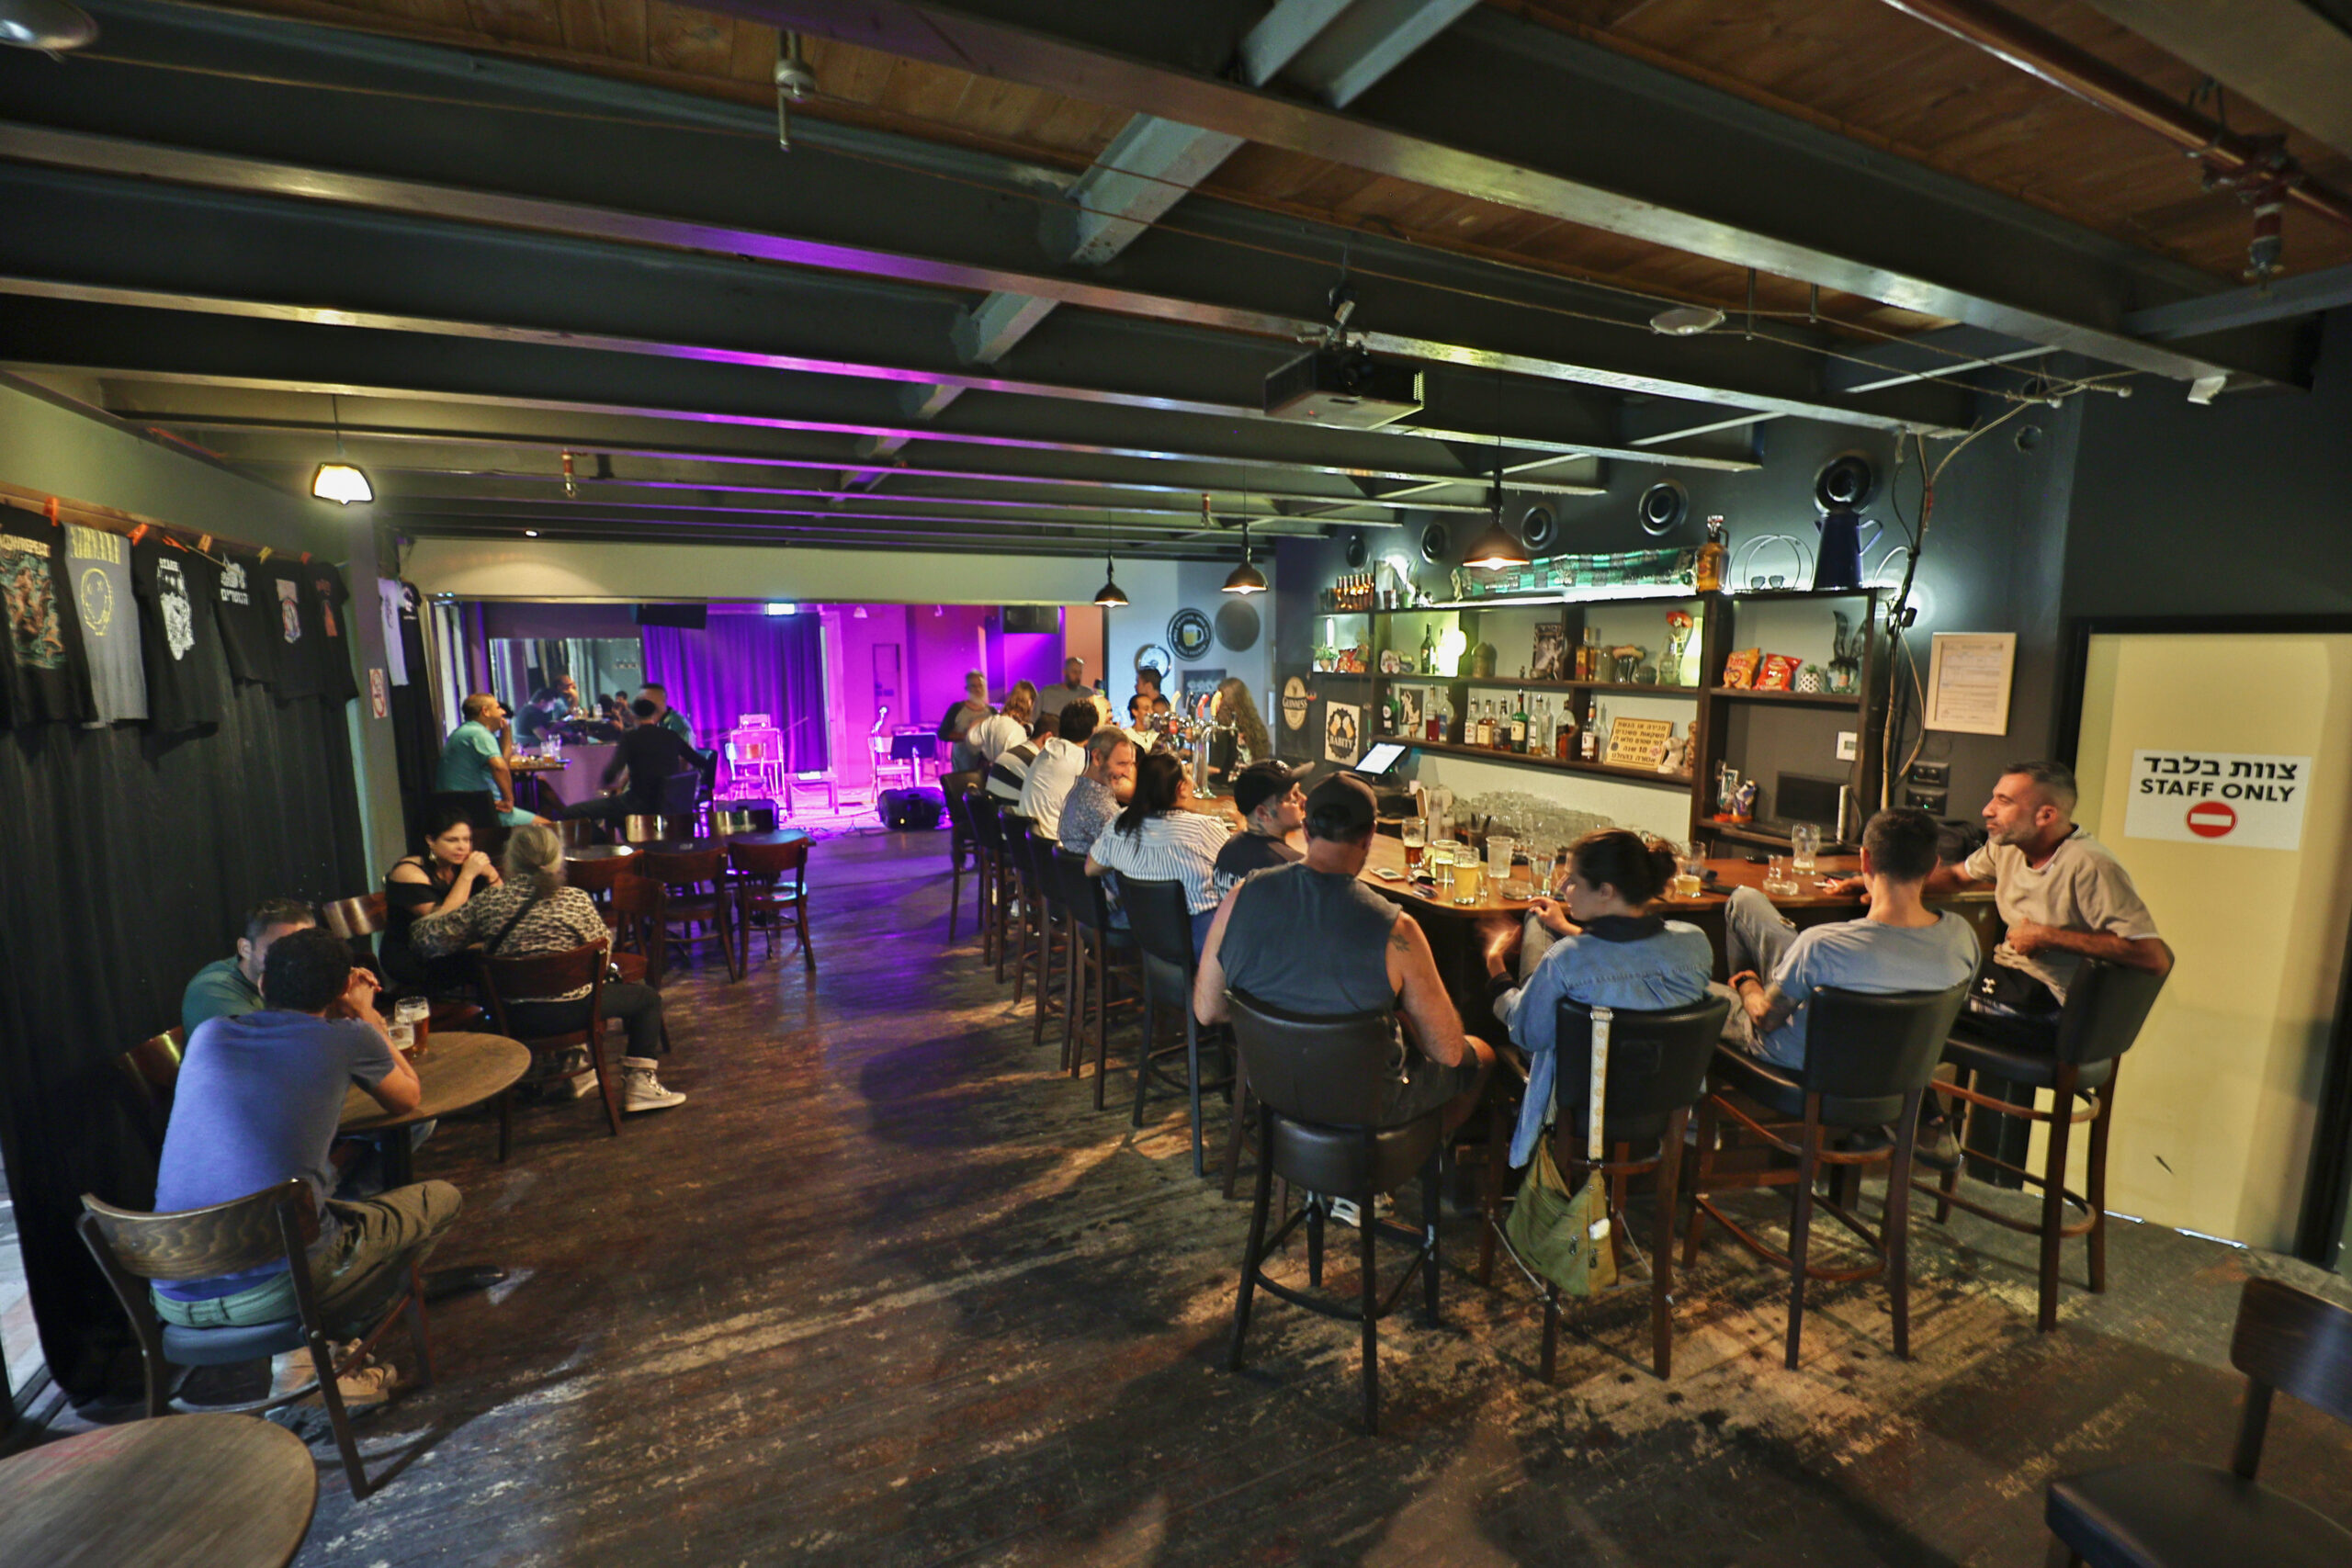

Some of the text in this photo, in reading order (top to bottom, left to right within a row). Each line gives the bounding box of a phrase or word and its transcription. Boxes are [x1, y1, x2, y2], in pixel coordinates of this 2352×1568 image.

[2143, 755, 2298, 780] צוות בלבד
[2140, 778, 2295, 803] STAFF ONLY
